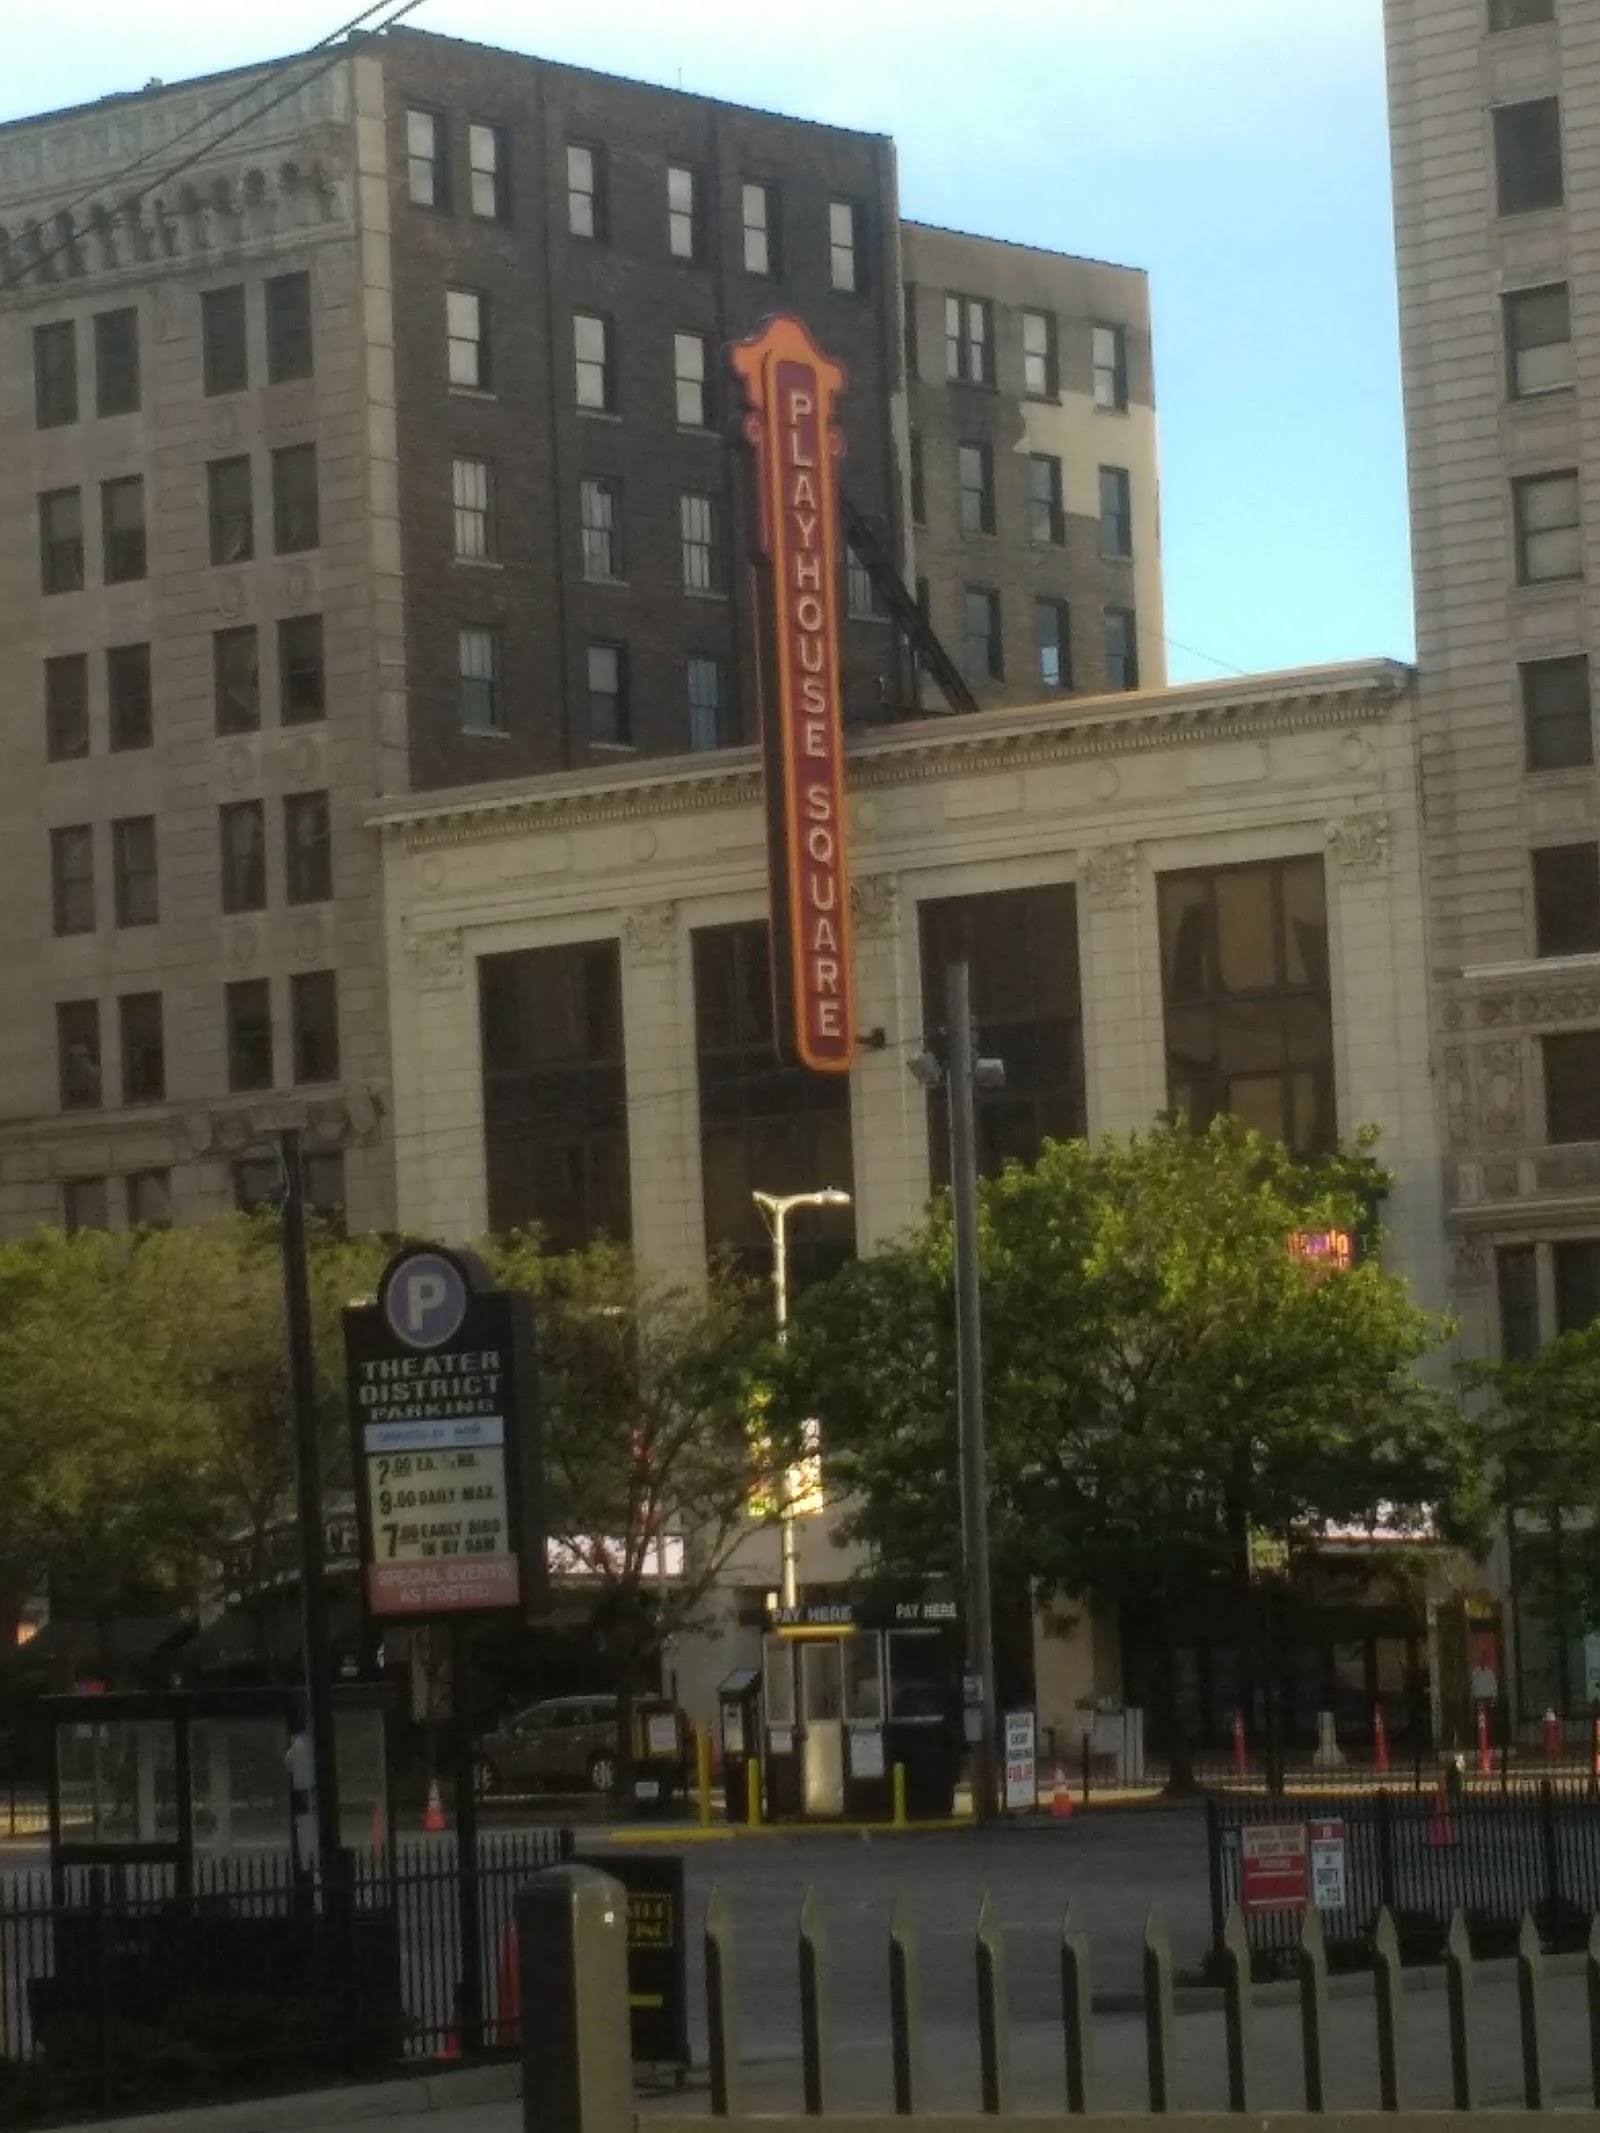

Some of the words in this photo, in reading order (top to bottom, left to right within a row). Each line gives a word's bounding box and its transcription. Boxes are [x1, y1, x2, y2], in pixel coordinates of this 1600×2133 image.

[789, 388, 826, 759] PLAYHOUSE
[807, 788, 842, 1037] SQUARE
[407, 1273, 447, 1332] P
[360, 1350, 501, 1381] THEATER
[359, 1373, 503, 1405] DISTRICT
[370, 1398, 495, 1422] PARKING
[772, 1607, 801, 1624] PAY
[807, 1604, 853, 1622] HERE
[895, 1602, 919, 1619] PAY
